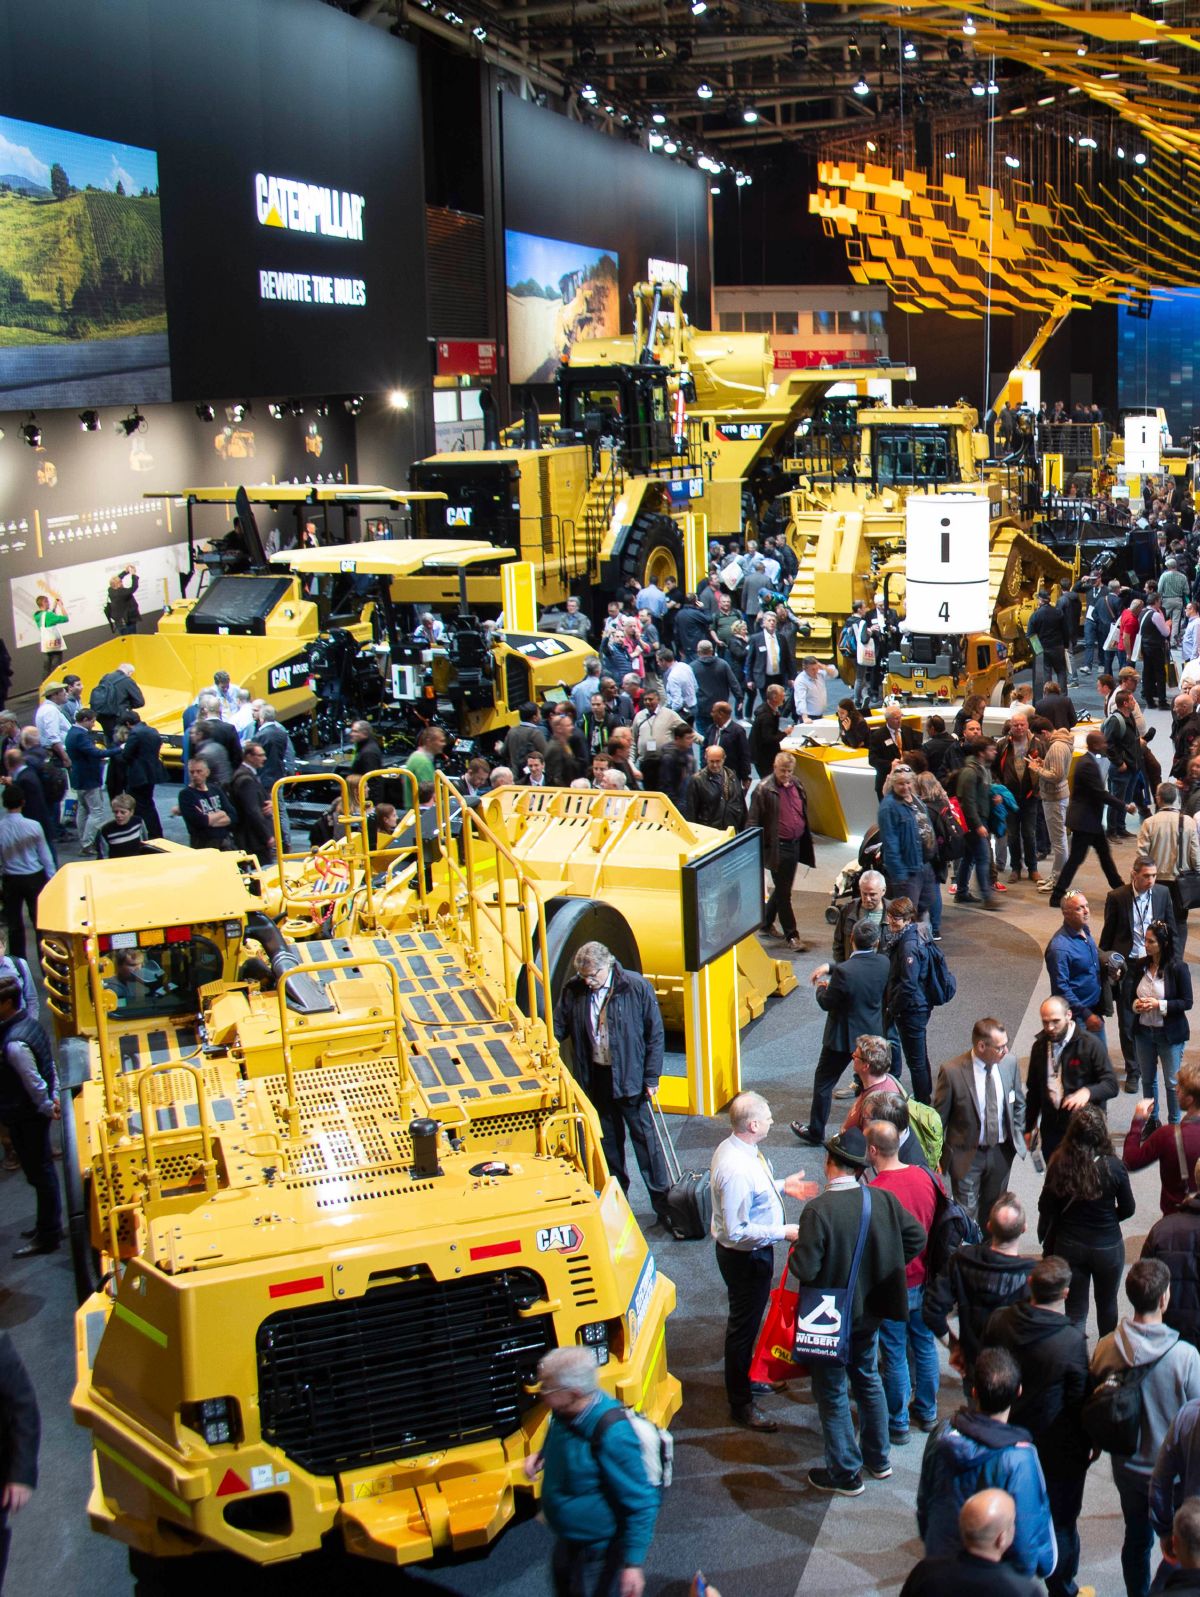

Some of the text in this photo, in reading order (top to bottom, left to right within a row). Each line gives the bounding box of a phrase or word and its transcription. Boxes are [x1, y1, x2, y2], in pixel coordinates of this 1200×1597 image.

[256, 172, 364, 241] CATERPILLAR
[260, 269, 366, 306] REWRITE THE RULES
[740, 424, 763, 440] CAT
[446, 507, 473, 526] CAT
[940, 518, 951, 563] i
[938, 601, 950, 623] 4
[271, 666, 292, 689] CAT
[536, 1225, 572, 1252] CAT
[796, 1333, 840, 1347] WILBERT
[796, 1347, 838, 1357] www.wilbert.de
